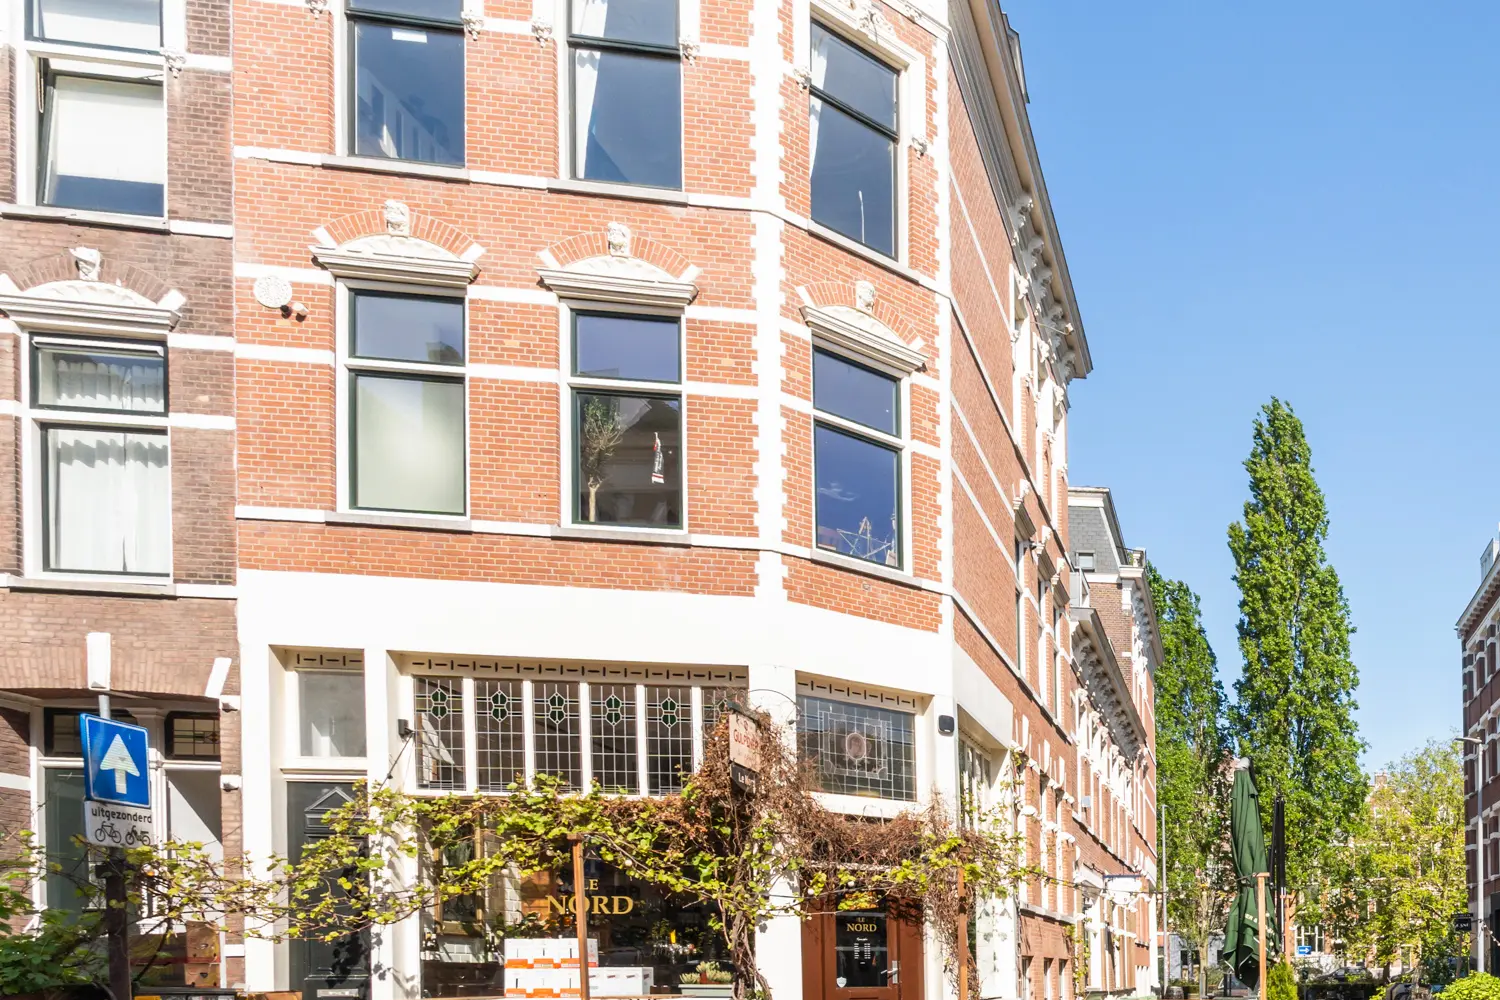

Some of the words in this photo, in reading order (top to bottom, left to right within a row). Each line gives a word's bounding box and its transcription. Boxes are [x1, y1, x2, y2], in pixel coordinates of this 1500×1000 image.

[91, 808, 152, 823] uitgezonderd
[545, 895, 634, 915] NORD
[847, 923, 877, 932] NORD
